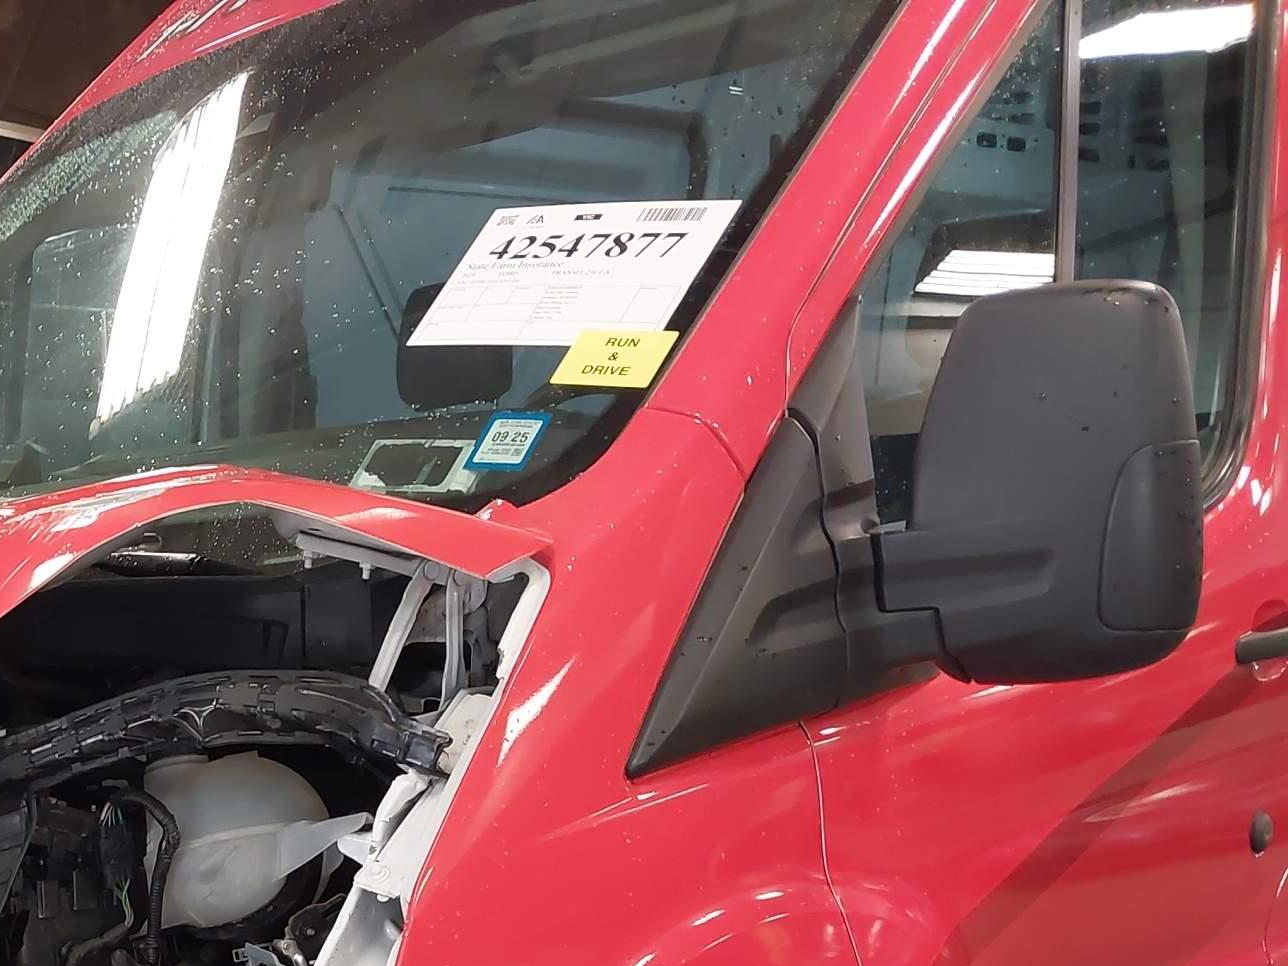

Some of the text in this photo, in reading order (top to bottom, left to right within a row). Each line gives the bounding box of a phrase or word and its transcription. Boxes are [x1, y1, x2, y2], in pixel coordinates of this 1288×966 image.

[489, 232, 689, 260] 42547877
[467, 260, 565, 271] State Farm Insurance
[605, 337, 640, 347] RUN
[608, 351, 619, 361] &
[581, 365, 632, 376] DRIVE
[491, 430, 530, 443] 09 25
